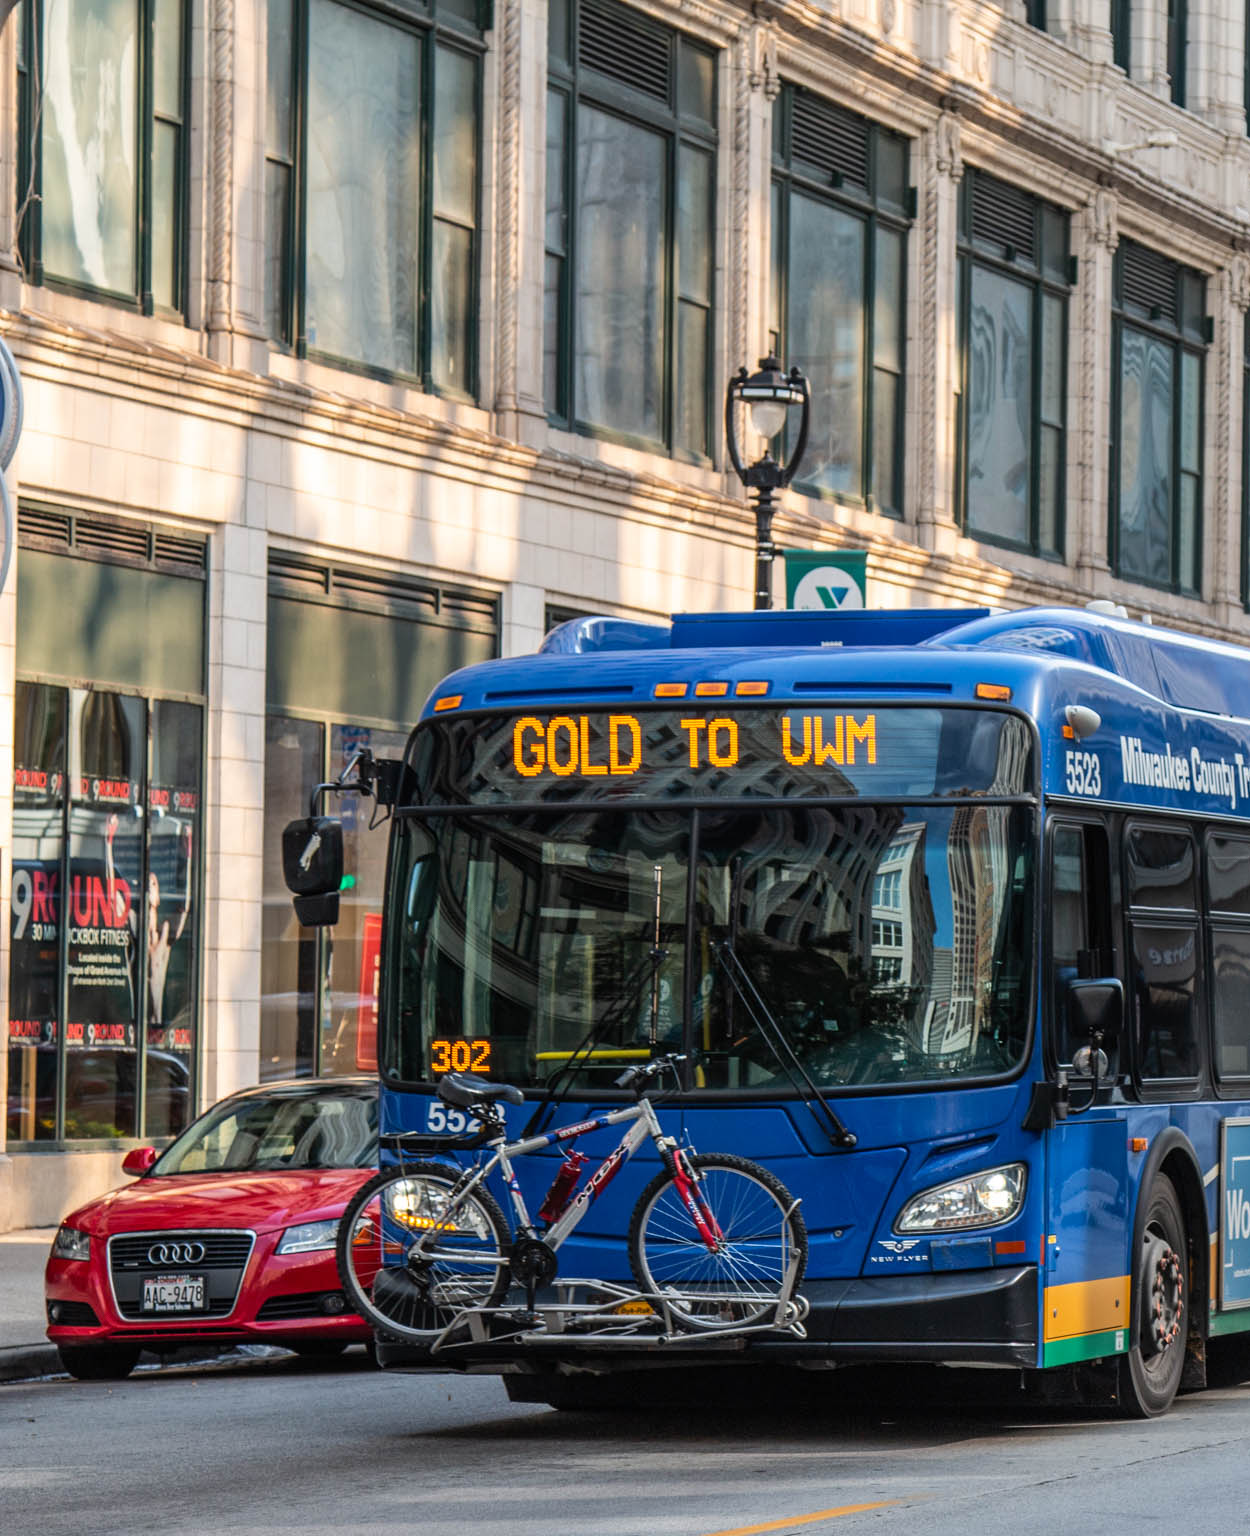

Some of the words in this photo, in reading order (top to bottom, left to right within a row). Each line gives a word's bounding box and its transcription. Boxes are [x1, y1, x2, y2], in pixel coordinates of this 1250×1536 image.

[512, 714, 643, 777] GOLD
[681, 717, 739, 769] TO
[782, 714, 877, 766] UWM
[15, 769, 48, 788] ROUND
[1065, 750, 1101, 797] 5523
[1120, 735, 1190, 792] Milwaukee
[1191, 746, 1236, 810] County
[31, 923, 43, 941] 30
[100, 929, 130, 946] FITNESS
[431, 1040, 491, 1072] 302
[144, 1285, 203, 1304] AAC-9478
